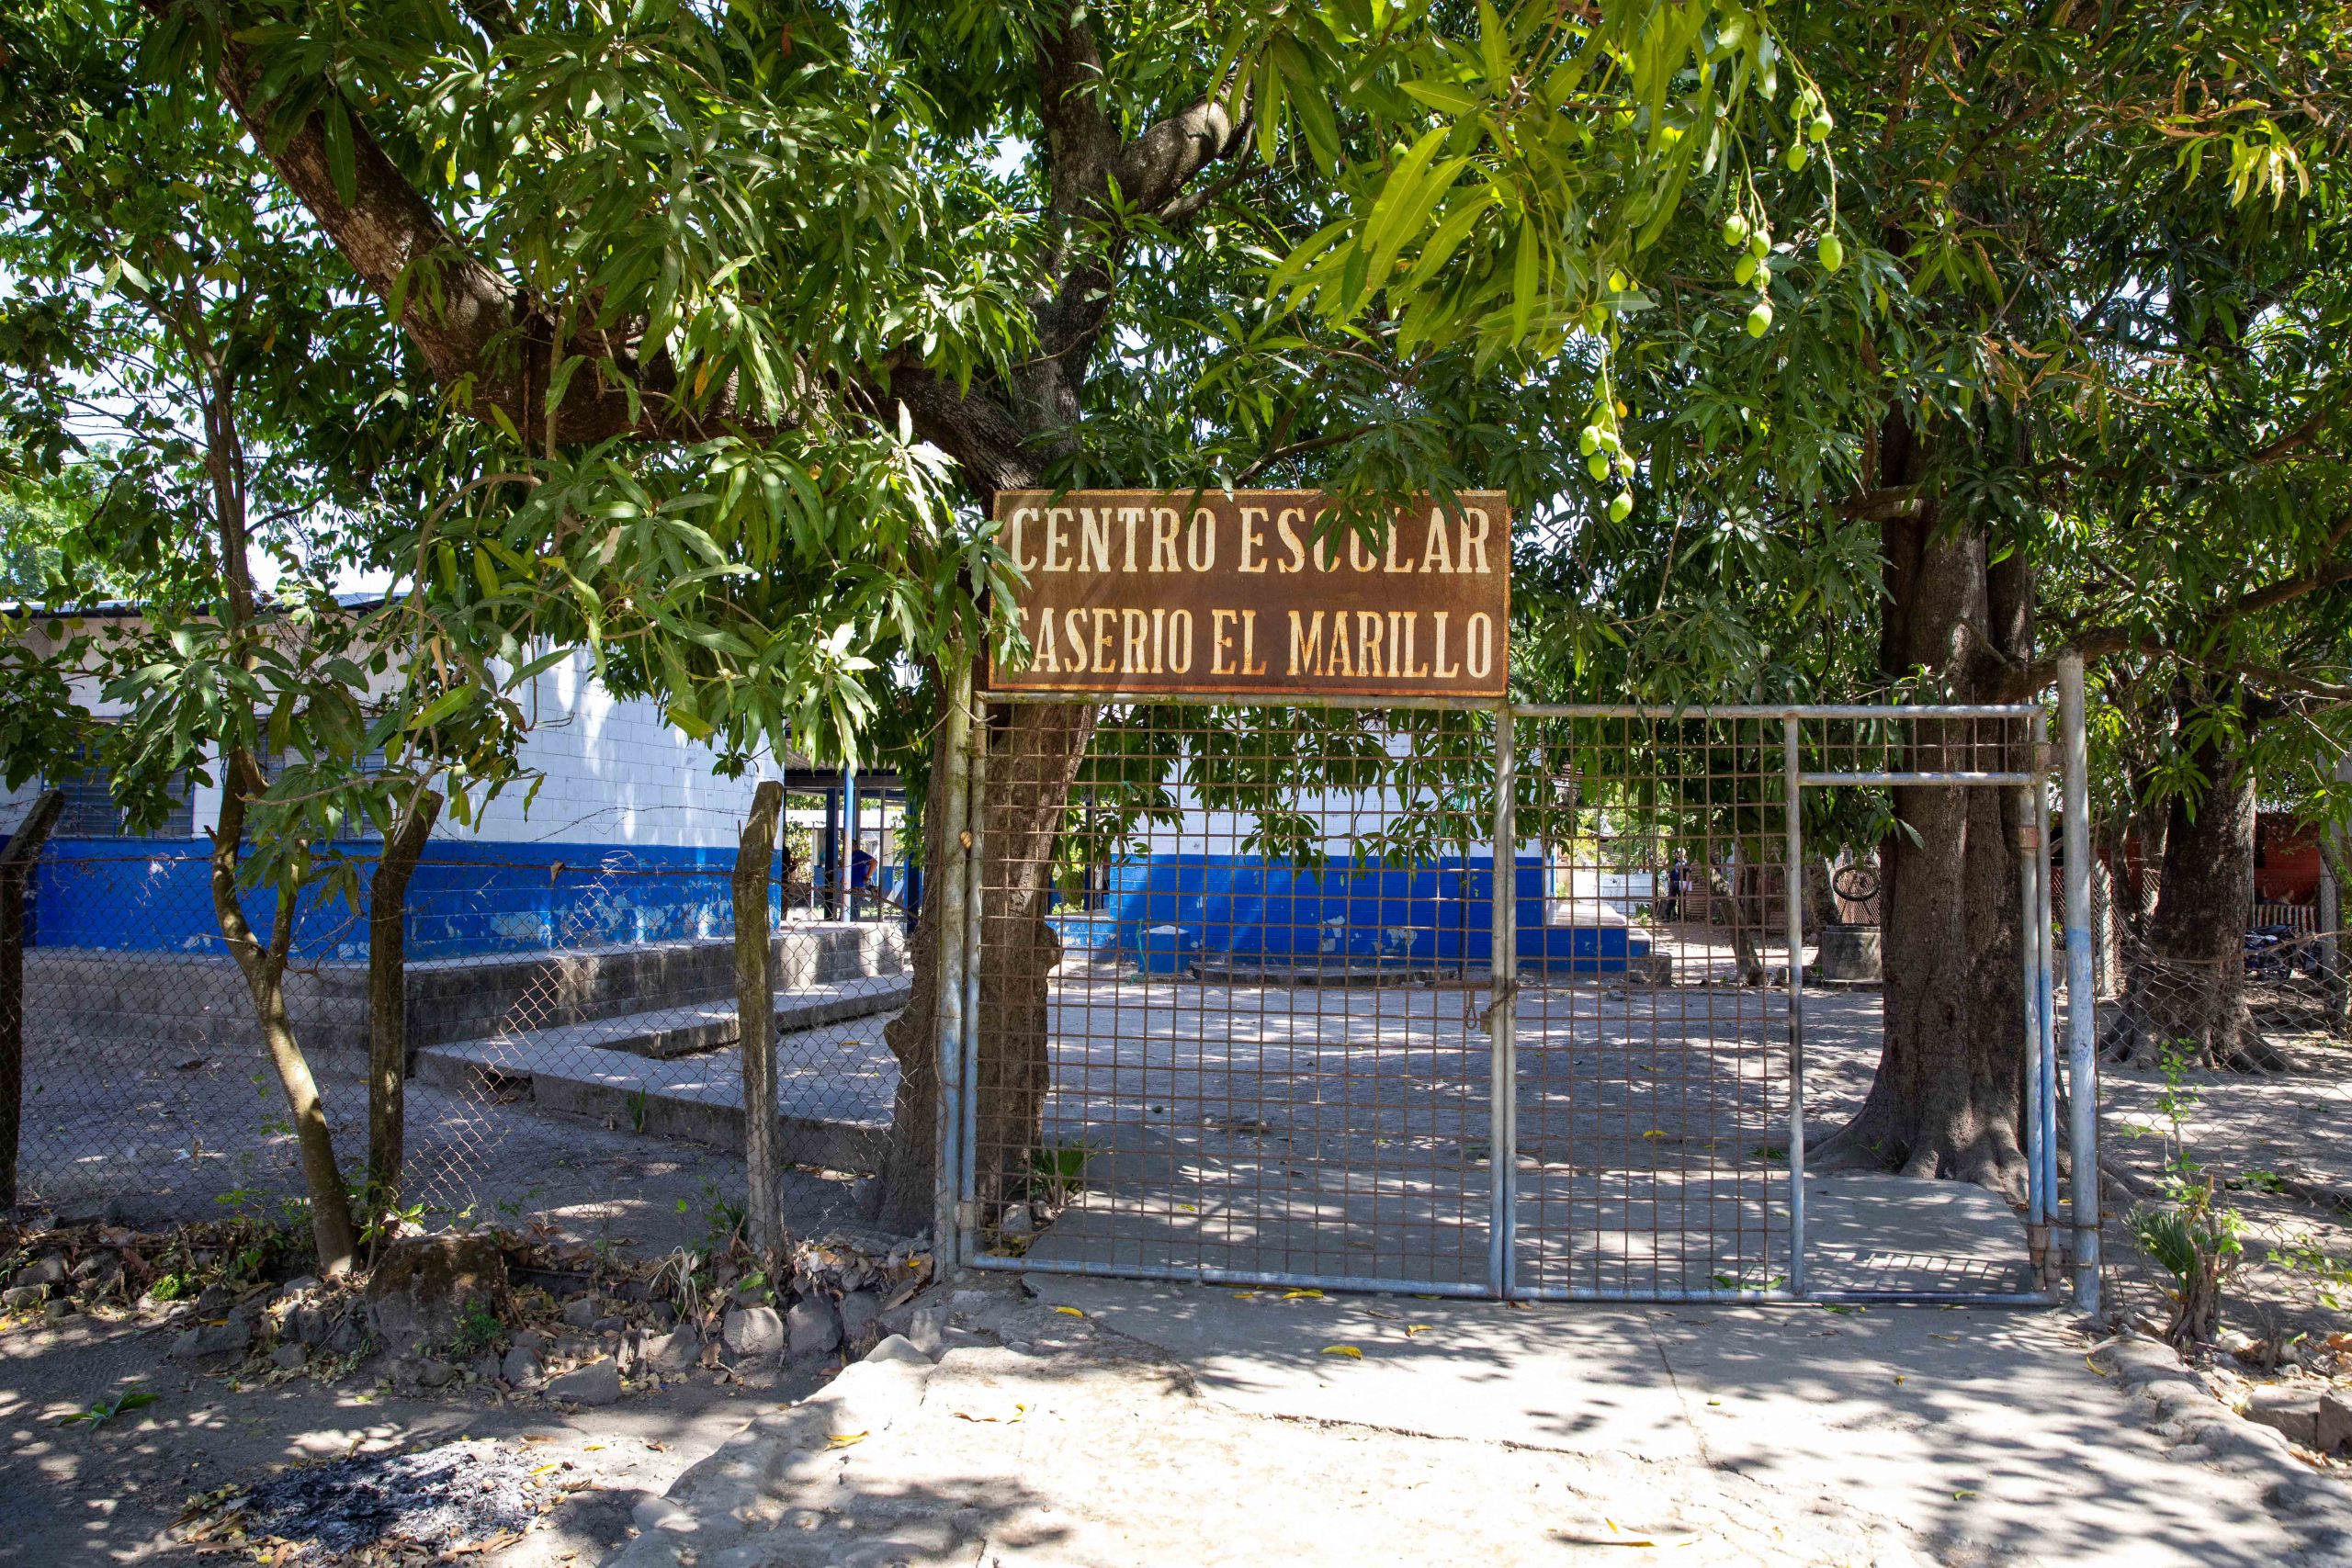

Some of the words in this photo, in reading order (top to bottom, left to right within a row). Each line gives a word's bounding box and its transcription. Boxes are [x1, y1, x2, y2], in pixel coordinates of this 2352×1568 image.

[1012, 507, 1216, 572] CENTRO
[1210, 609, 1267, 675] EL
[1286, 610, 1492, 679] MARILLO
